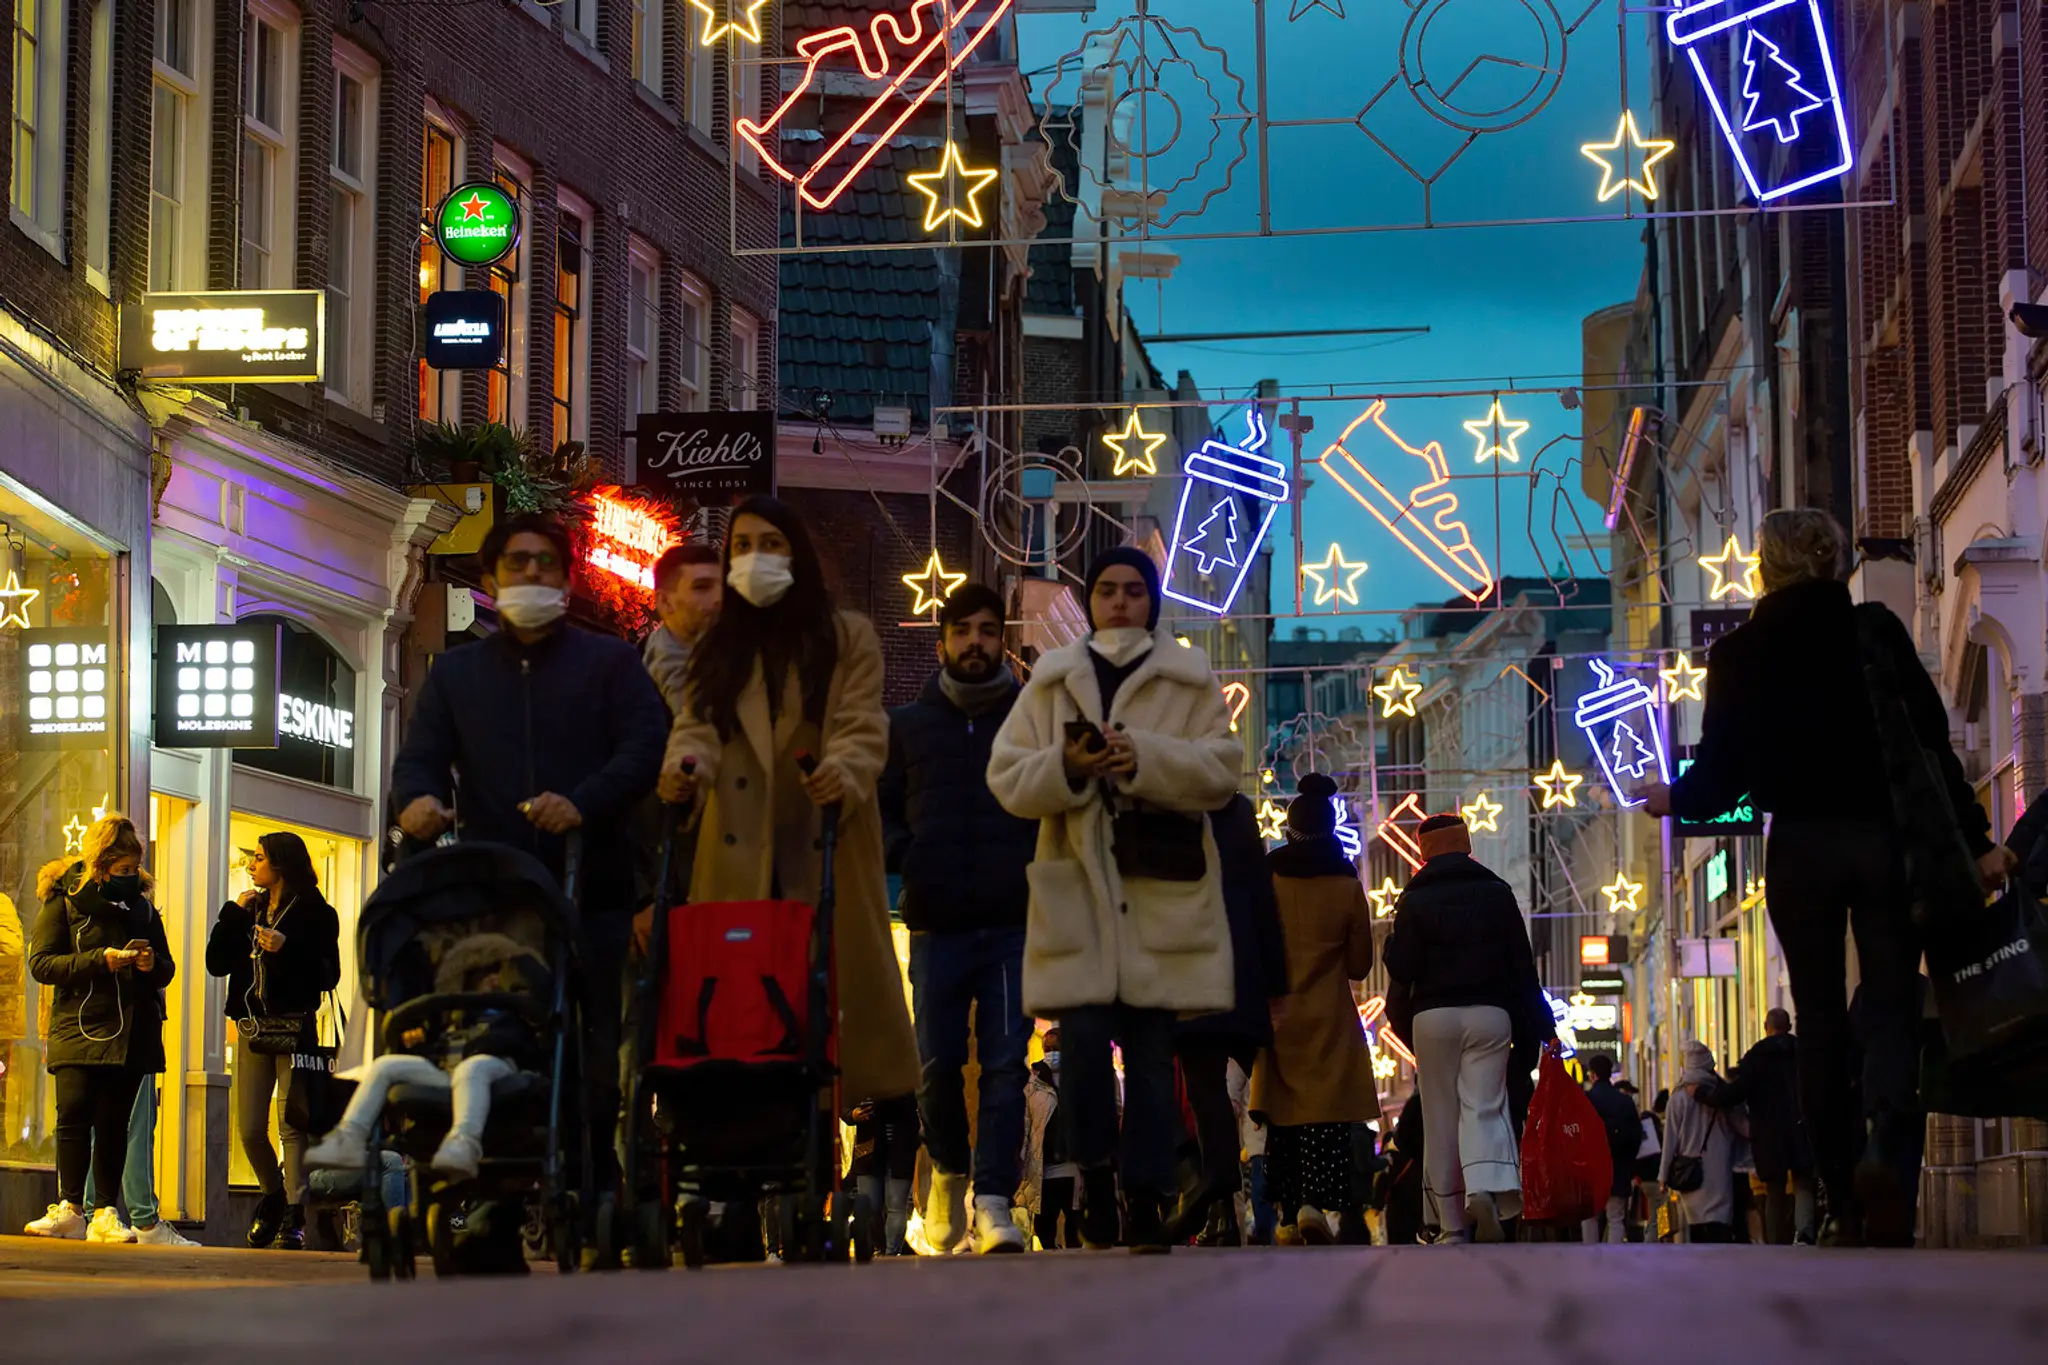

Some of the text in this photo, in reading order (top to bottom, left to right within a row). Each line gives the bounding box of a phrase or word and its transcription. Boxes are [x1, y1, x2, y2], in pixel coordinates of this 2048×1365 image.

[445, 225, 507, 239] Heineken
[252, 352, 273, 361] Foot
[648, 429, 762, 468] Kiehl's
[674, 480, 713, 489] SINCE
[176, 642, 202, 663] M
[177, 720, 253, 731] MOLESKINE
[1952, 938, 2030, 984] THE STING
